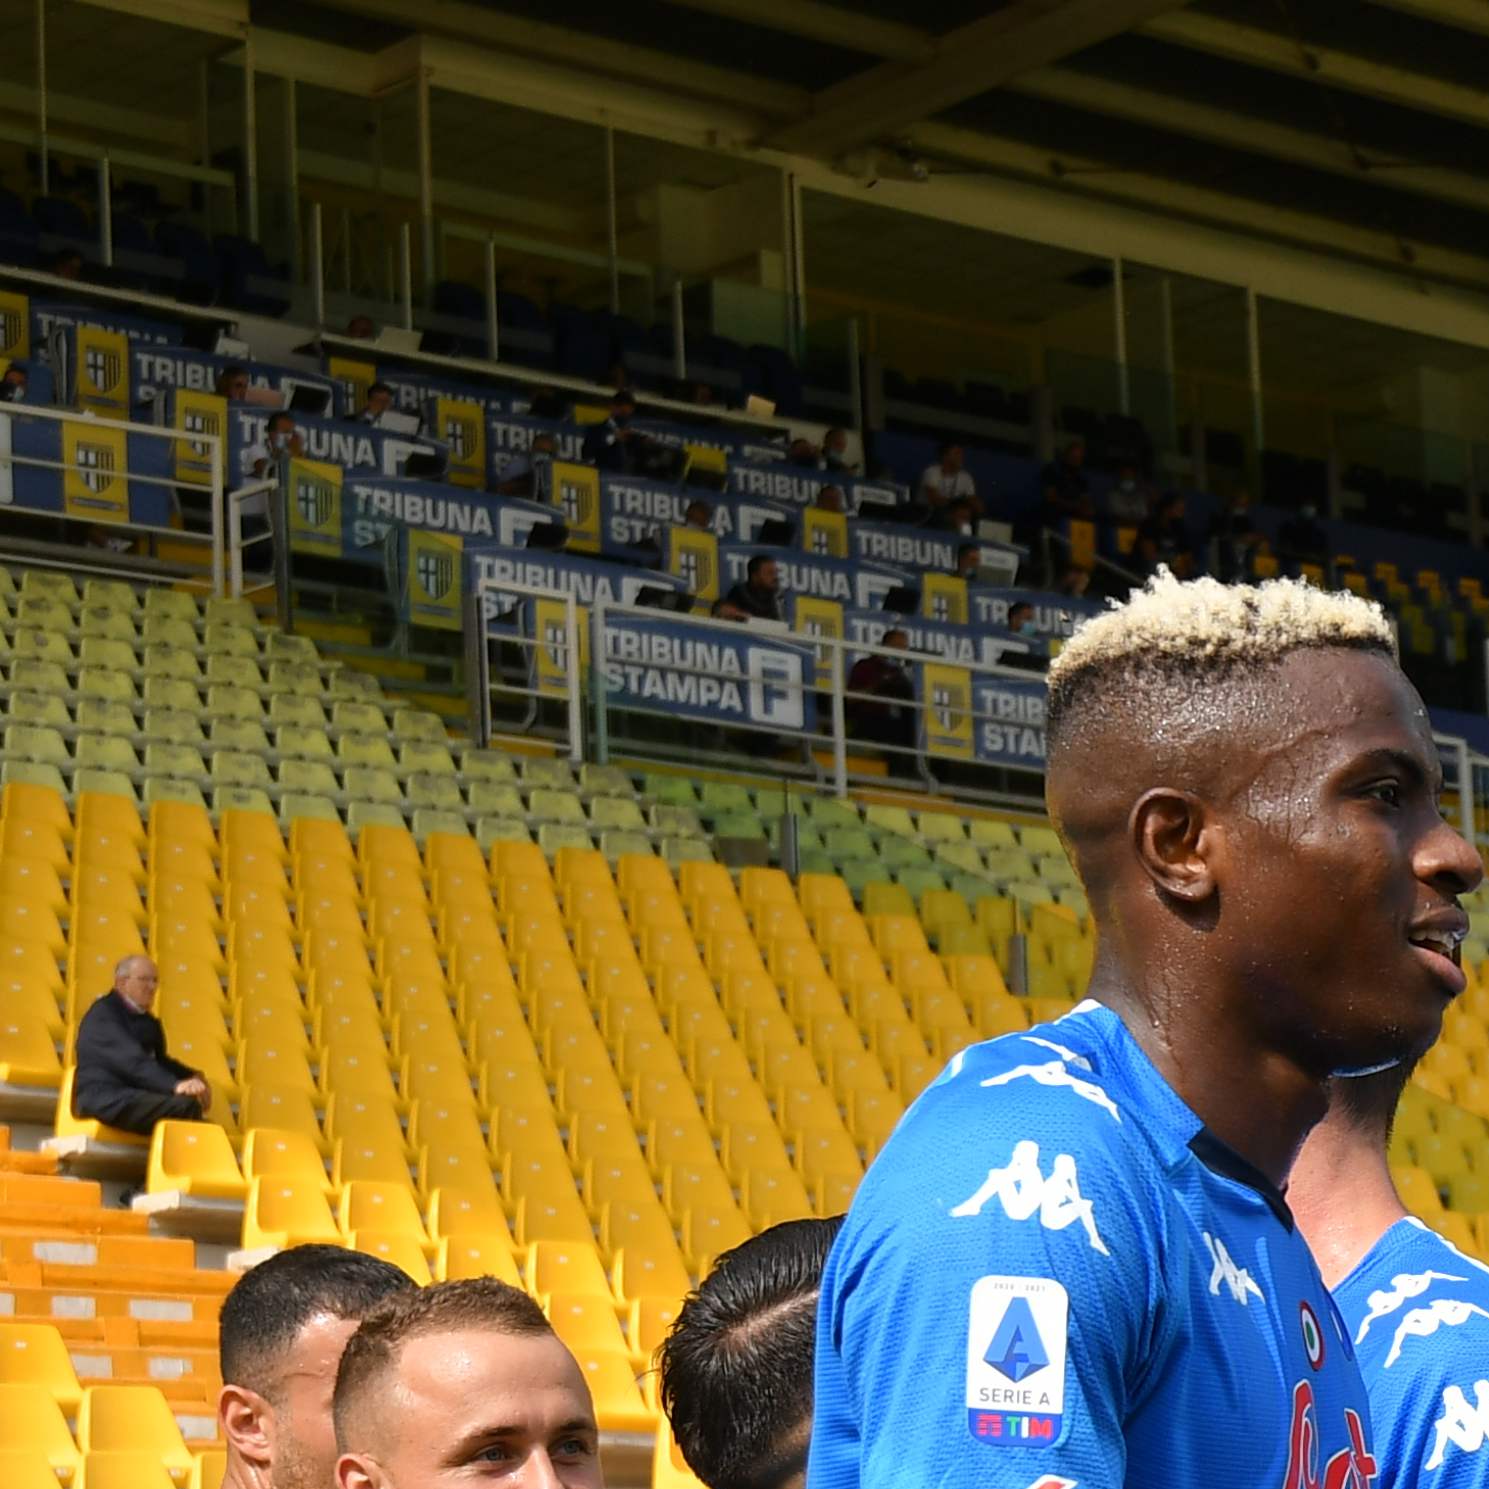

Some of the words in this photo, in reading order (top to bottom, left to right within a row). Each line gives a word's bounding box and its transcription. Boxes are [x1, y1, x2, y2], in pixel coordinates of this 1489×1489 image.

[352, 485, 494, 537] TRIBUNA
[855, 529, 959, 571] TRIBUN
[602, 627, 742, 676] TRIBUNA
[604, 664, 744, 713] STAMPA
[979, 1387, 1033, 1405] SERIE
[1039, 1392, 1051, 1406] A
[1006, 1416, 1053, 1440] TIM
